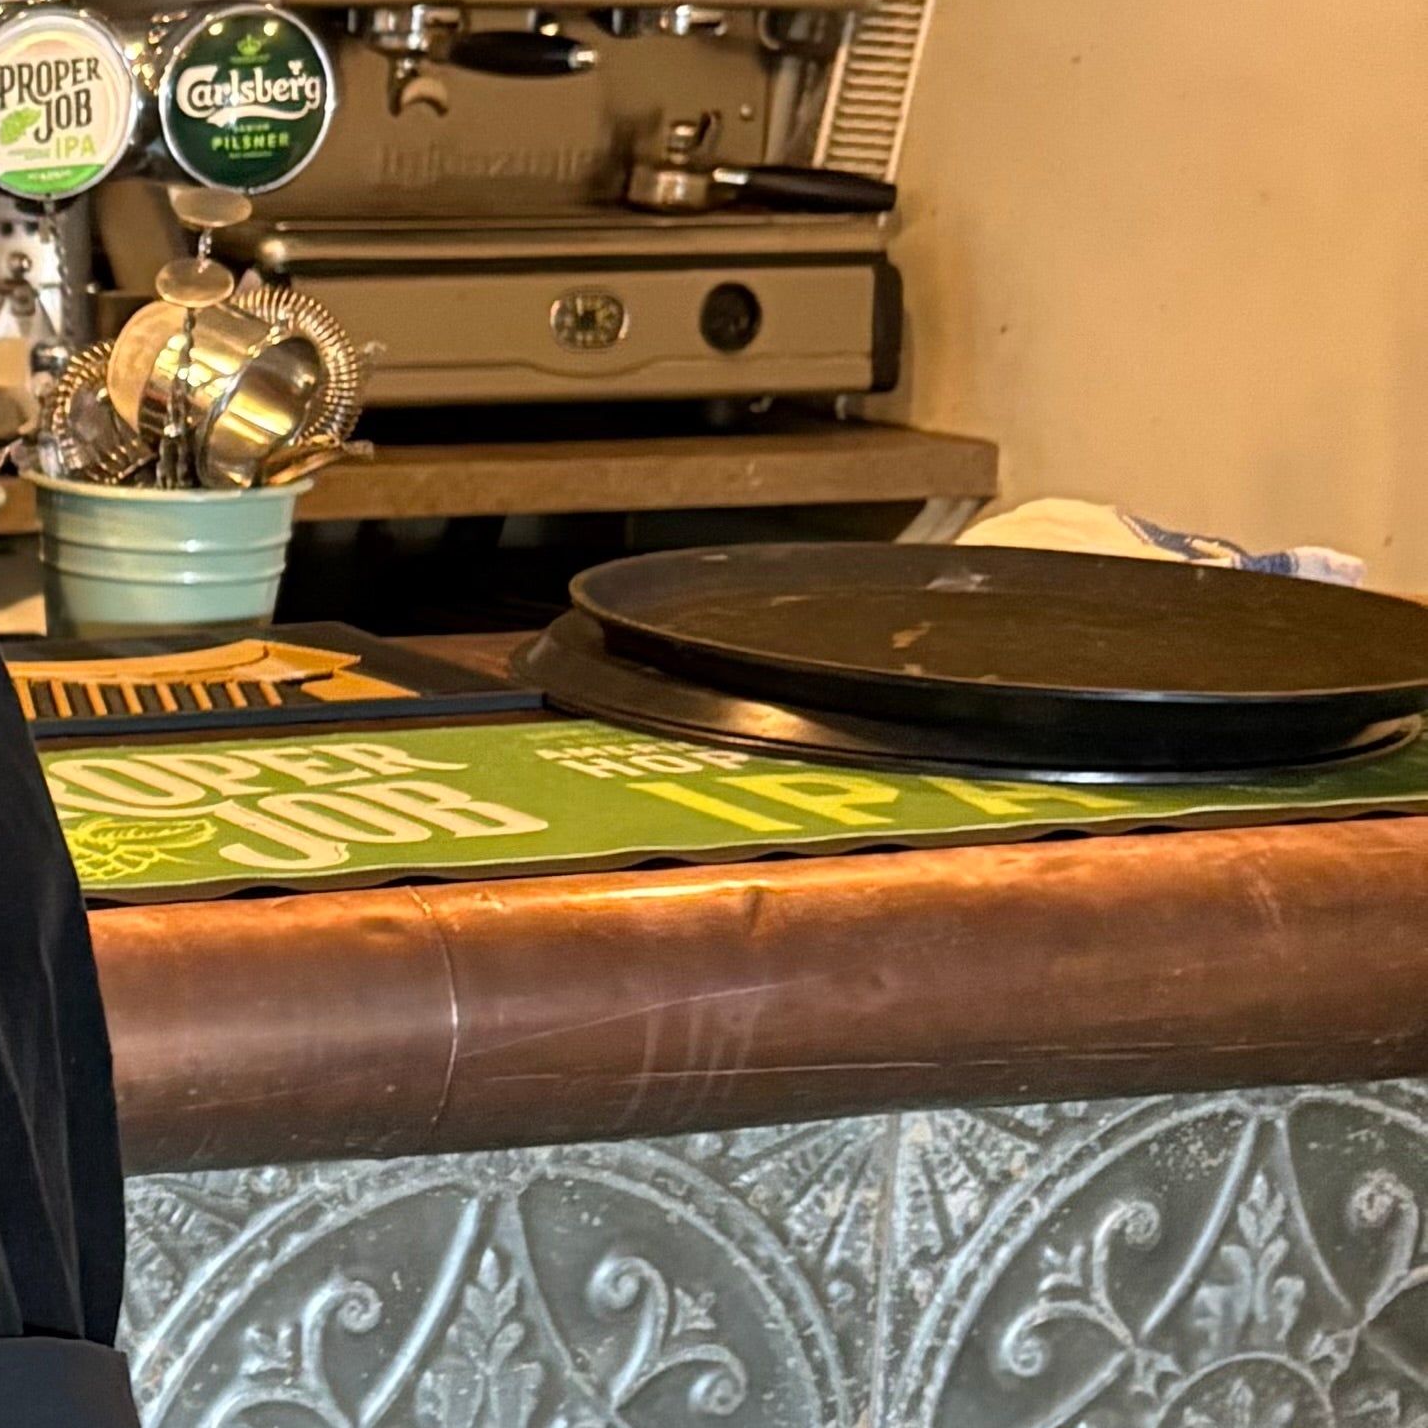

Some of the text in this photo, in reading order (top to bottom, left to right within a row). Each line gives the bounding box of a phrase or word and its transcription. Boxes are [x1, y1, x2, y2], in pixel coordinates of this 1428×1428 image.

[33, 87, 93, 144] JOB
[176, 60, 321, 124] Carlsberg
[55, 134, 96, 159] IPA
[211, 132, 290, 151] PILSNER
[219, 780, 549, 869] JOB
[626, 772, 1142, 833] IPA
